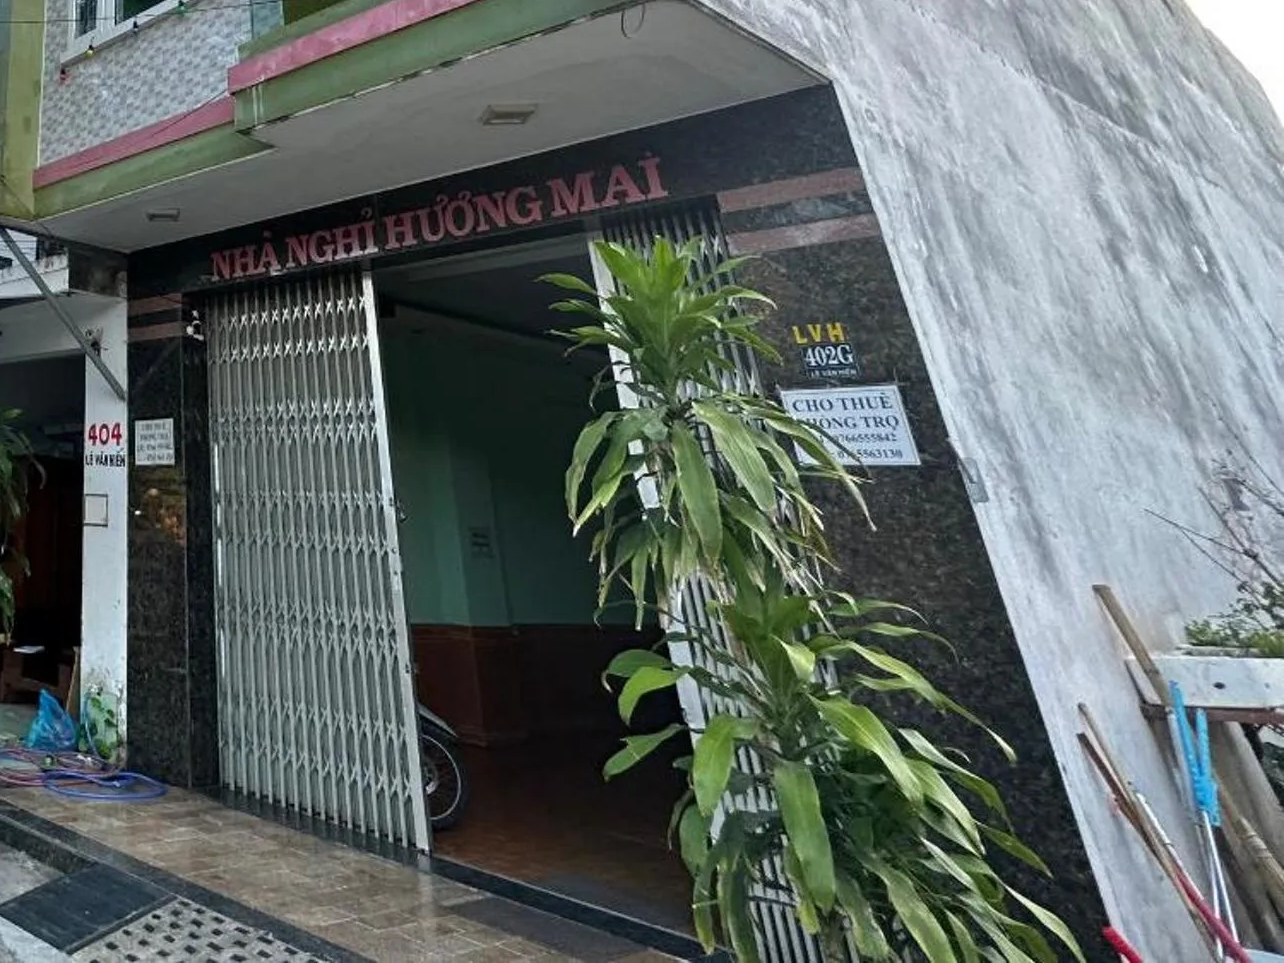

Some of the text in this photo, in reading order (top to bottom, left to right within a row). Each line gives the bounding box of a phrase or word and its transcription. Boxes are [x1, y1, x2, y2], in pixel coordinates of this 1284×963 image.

[285, 207, 378, 269] NGHỈ
[549, 152, 669, 216] MAI
[805, 344, 854, 367] 402G
[792, 392, 893, 413] CHO THUÊ
[88, 422, 122, 446] 404
[860, 415, 900, 431] TRỌ
